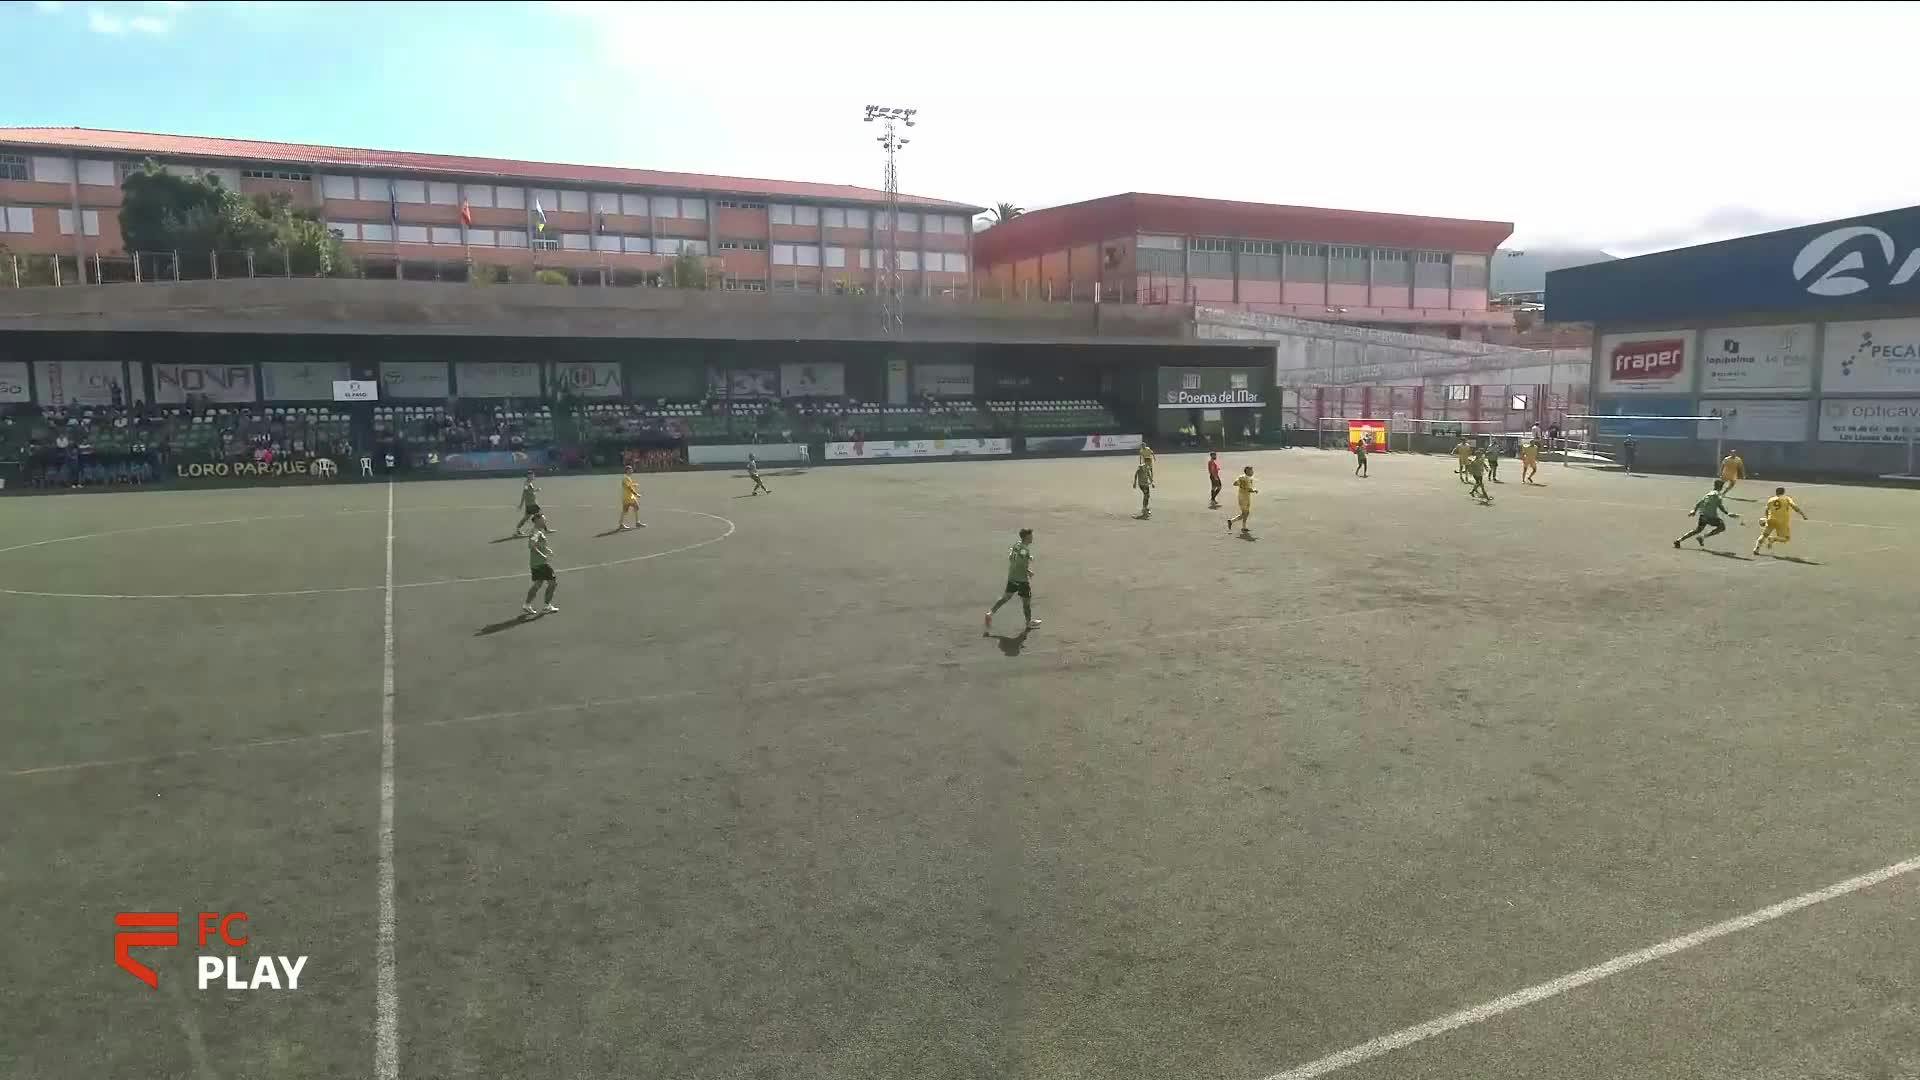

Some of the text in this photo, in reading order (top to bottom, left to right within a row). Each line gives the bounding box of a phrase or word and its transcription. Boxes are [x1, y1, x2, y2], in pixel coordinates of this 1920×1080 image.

[1615, 349, 1681, 371] fraper
[1178, 389, 1258, 404] Poema del Mar
[177, 460, 307, 477] LORO PARQUE
